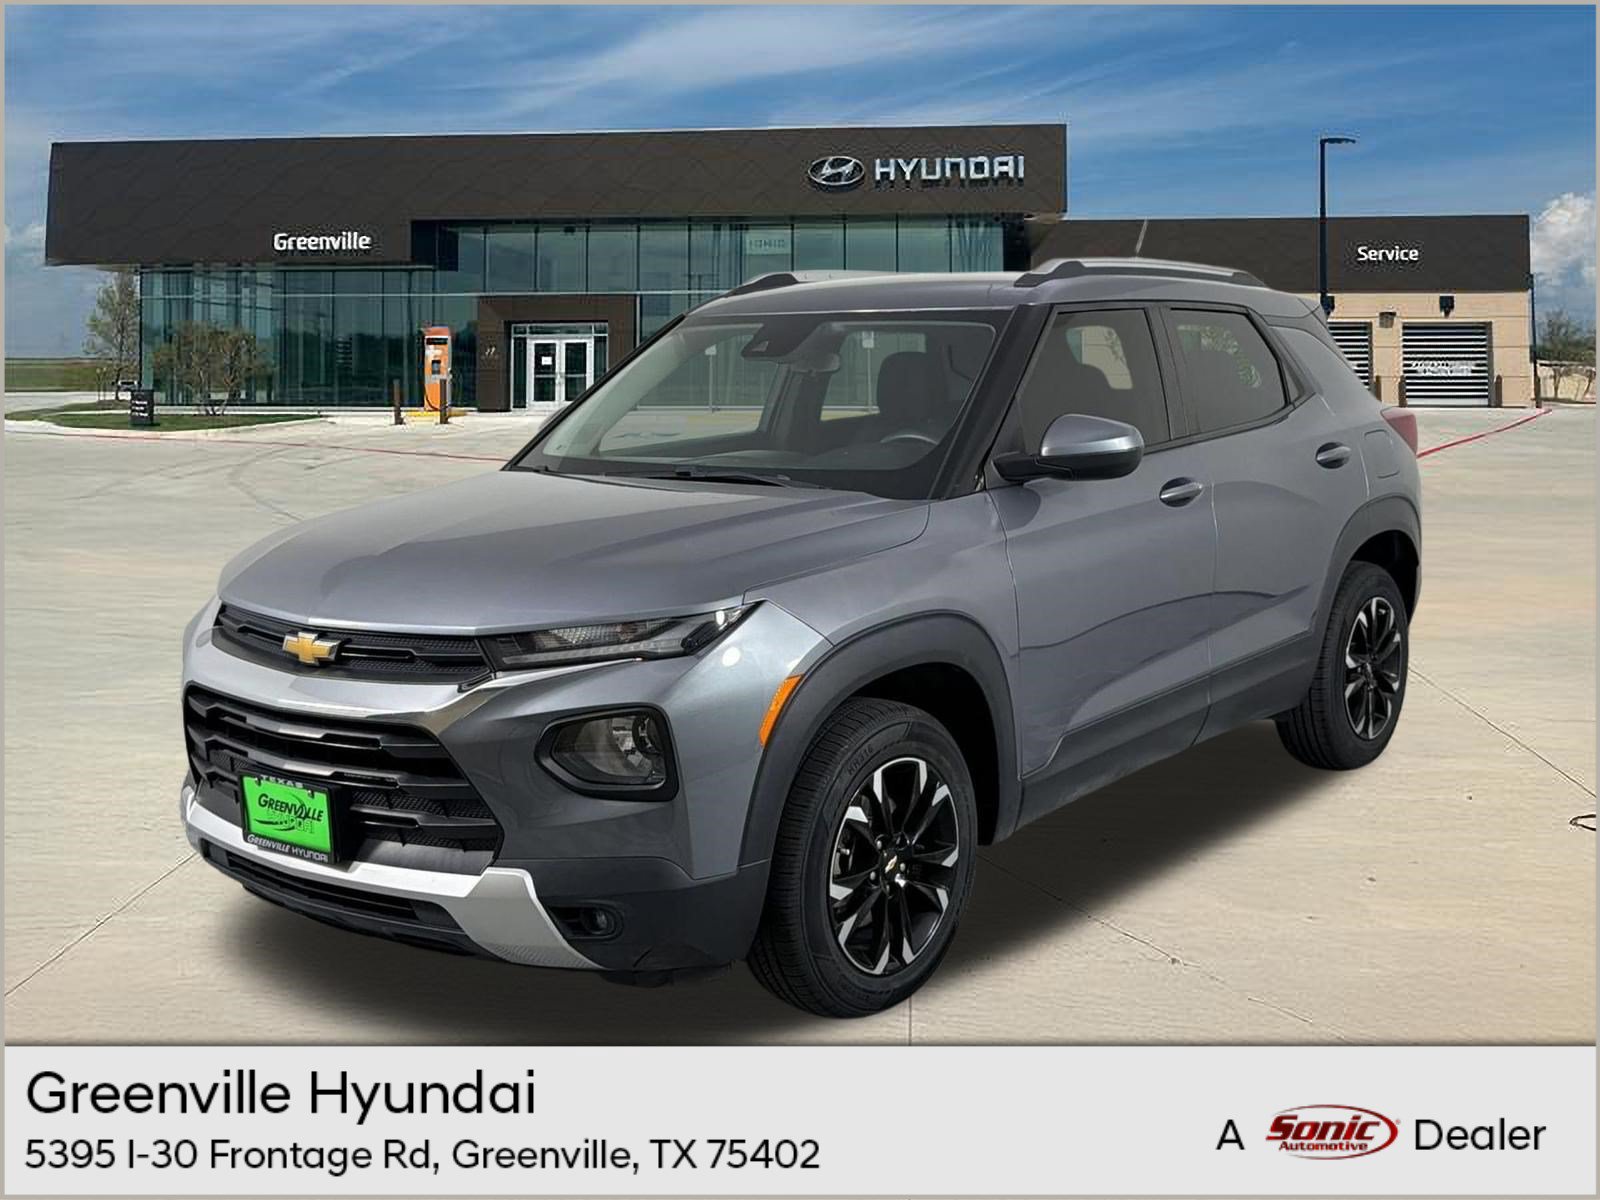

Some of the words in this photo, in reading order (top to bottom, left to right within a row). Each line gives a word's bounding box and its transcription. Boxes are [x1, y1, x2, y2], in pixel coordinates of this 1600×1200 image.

[875, 155, 1025, 181] HYUNDAI
[273, 231, 371, 251] Greenville
[1357, 245, 1419, 262] Service
[260, 774, 304, 788] TEXAS
[257, 793, 324, 822] GREENVILLE
[247, 834, 291, 853] GREENVILLE
